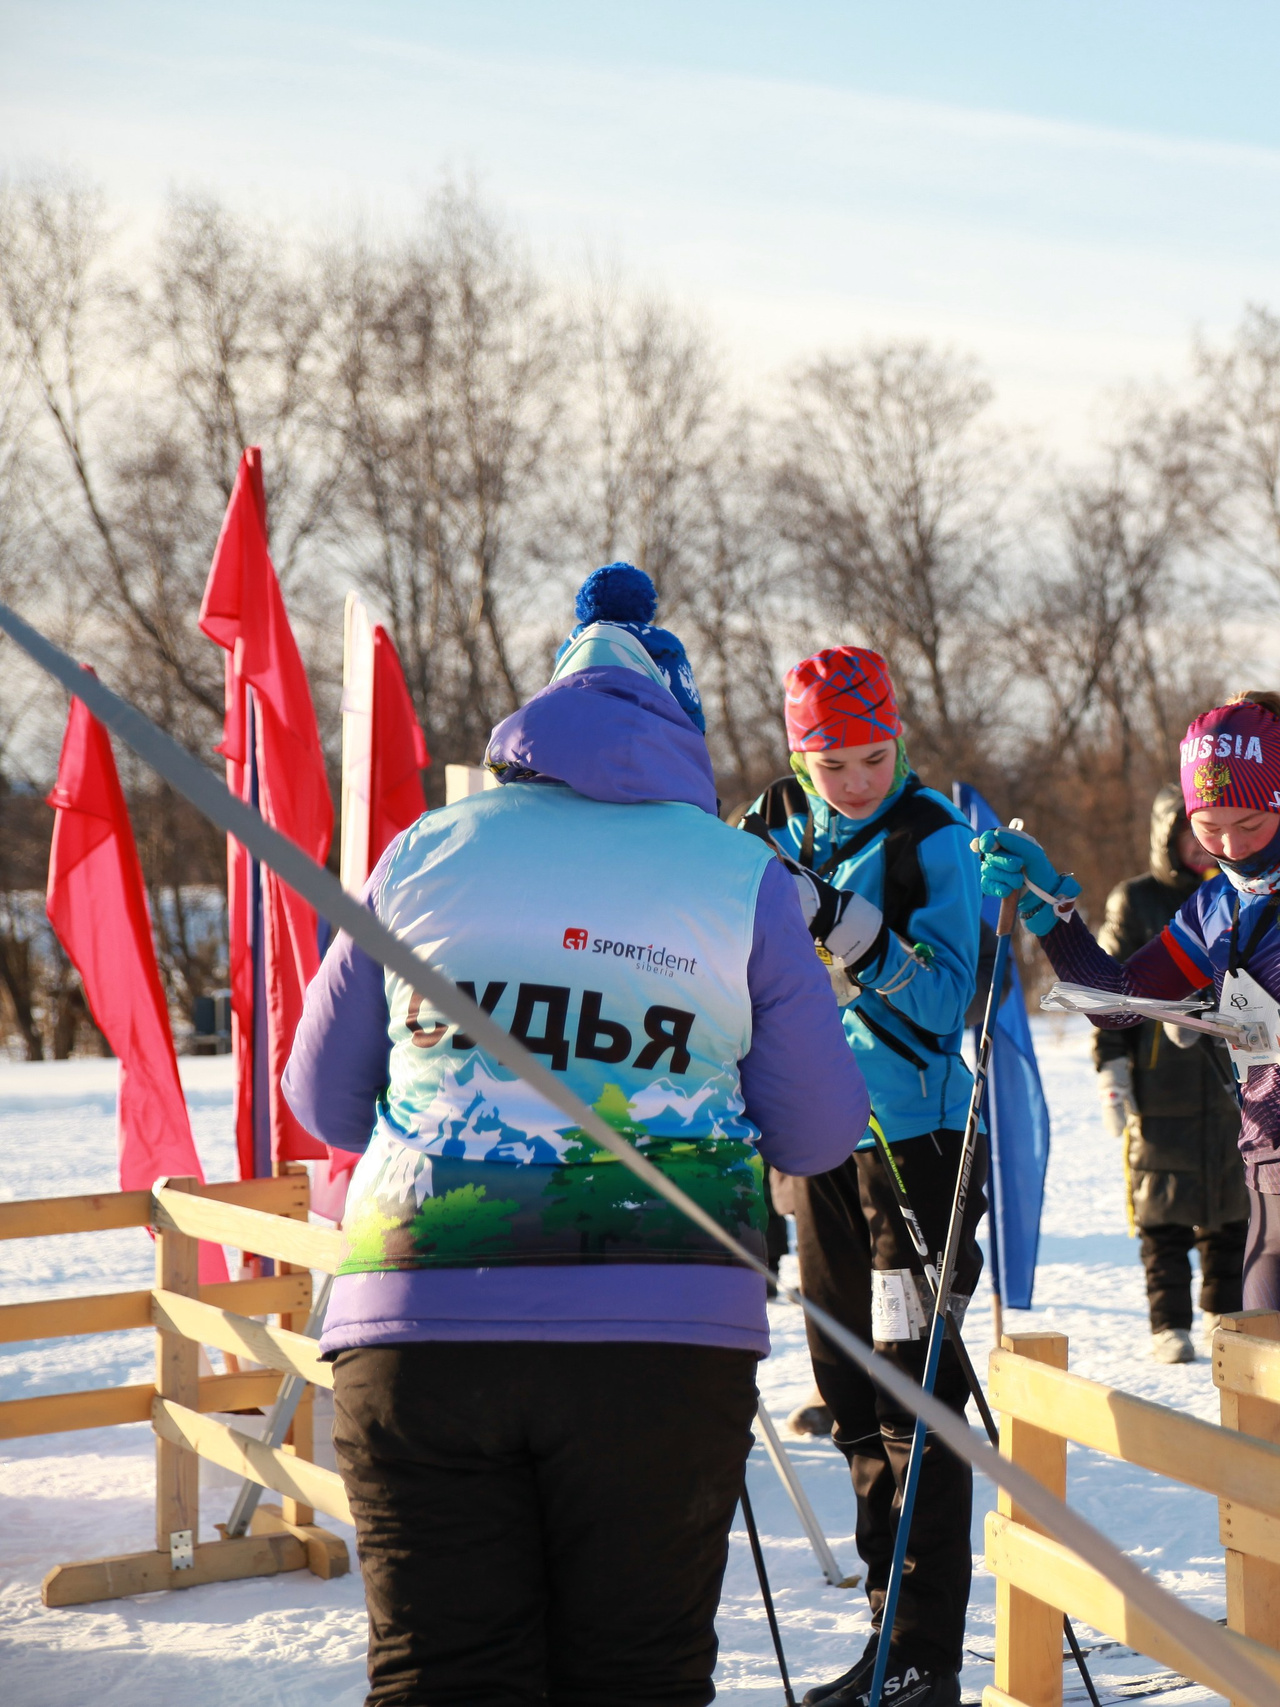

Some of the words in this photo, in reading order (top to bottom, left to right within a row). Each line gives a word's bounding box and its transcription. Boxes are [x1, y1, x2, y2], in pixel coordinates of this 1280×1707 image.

[1180, 733, 1263, 769] RUSSIA
[592, 939, 698, 975] SPORTident
[635, 961, 674, 978] siberia
[956, 1155, 974, 1214] CYBER
